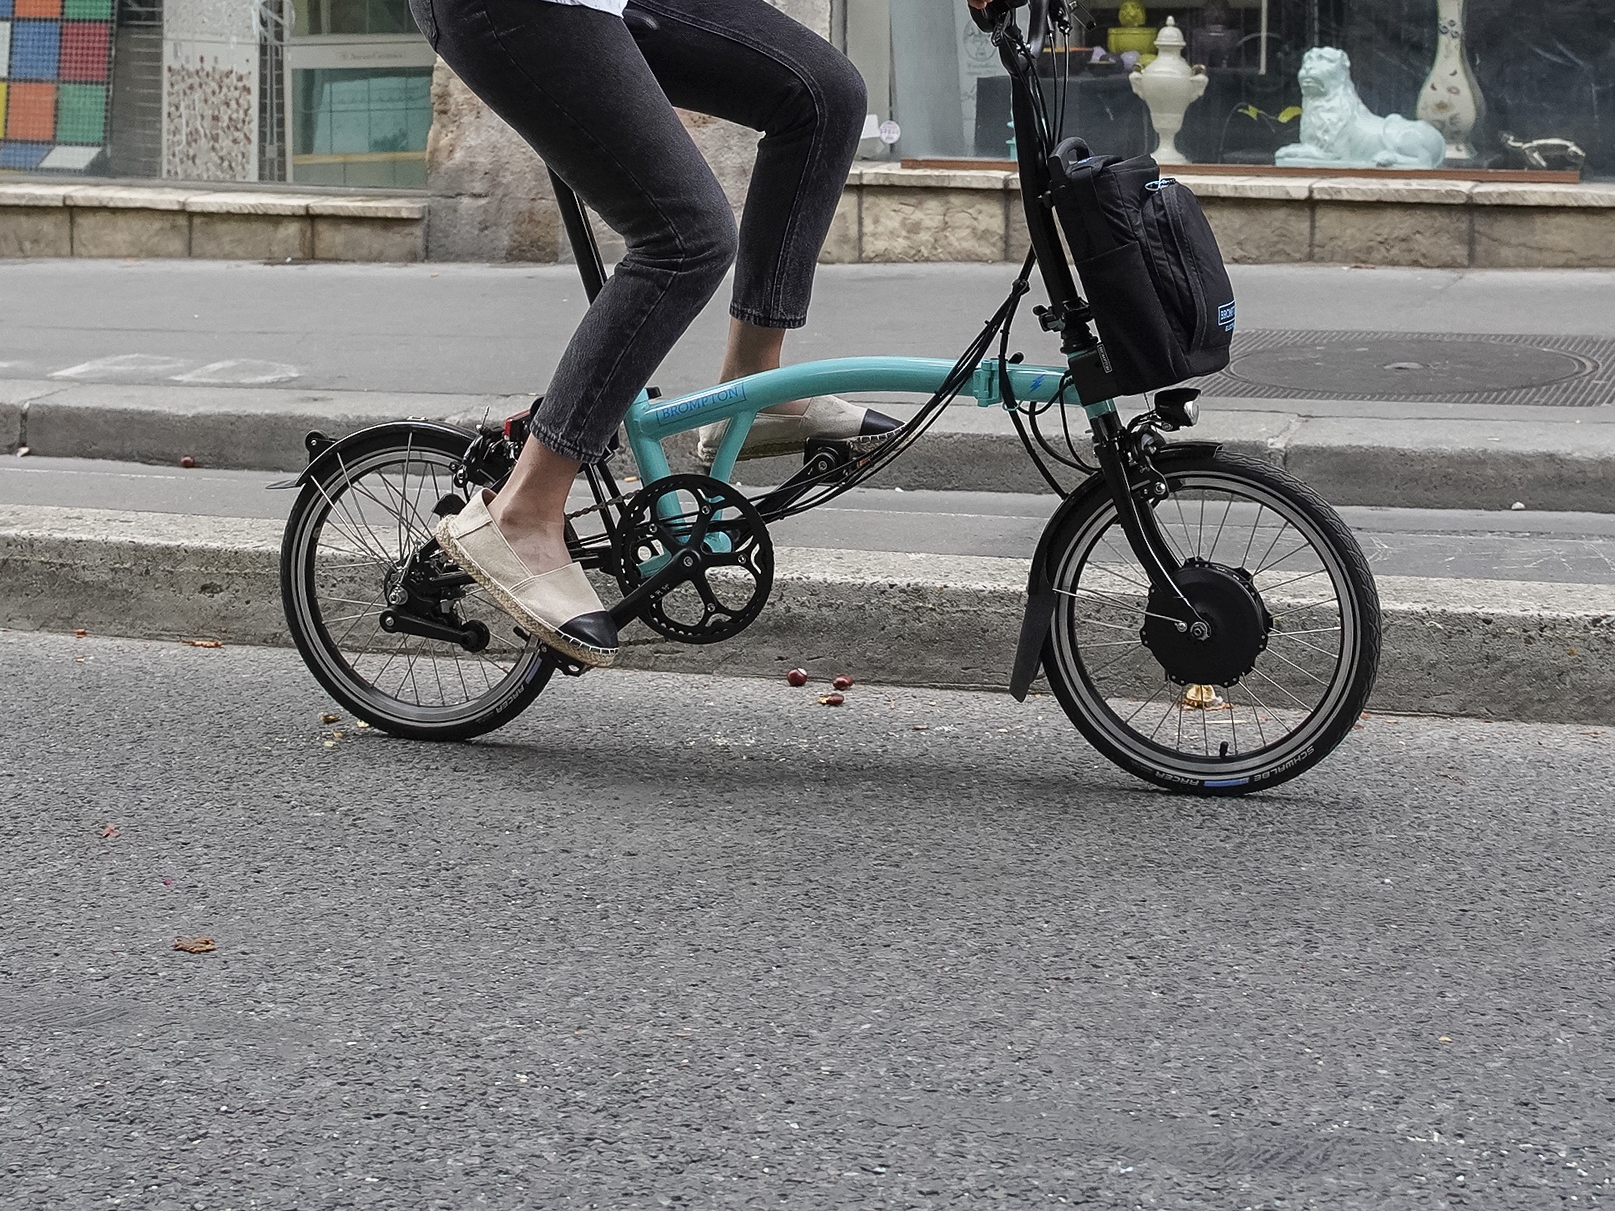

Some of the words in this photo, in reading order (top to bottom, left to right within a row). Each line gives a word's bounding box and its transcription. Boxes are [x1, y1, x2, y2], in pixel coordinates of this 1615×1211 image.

[661, 386, 739, 420] BROMPTON
[1155, 770, 1200, 786] RACER
[1253, 745, 1315, 782] SCHWALBE
